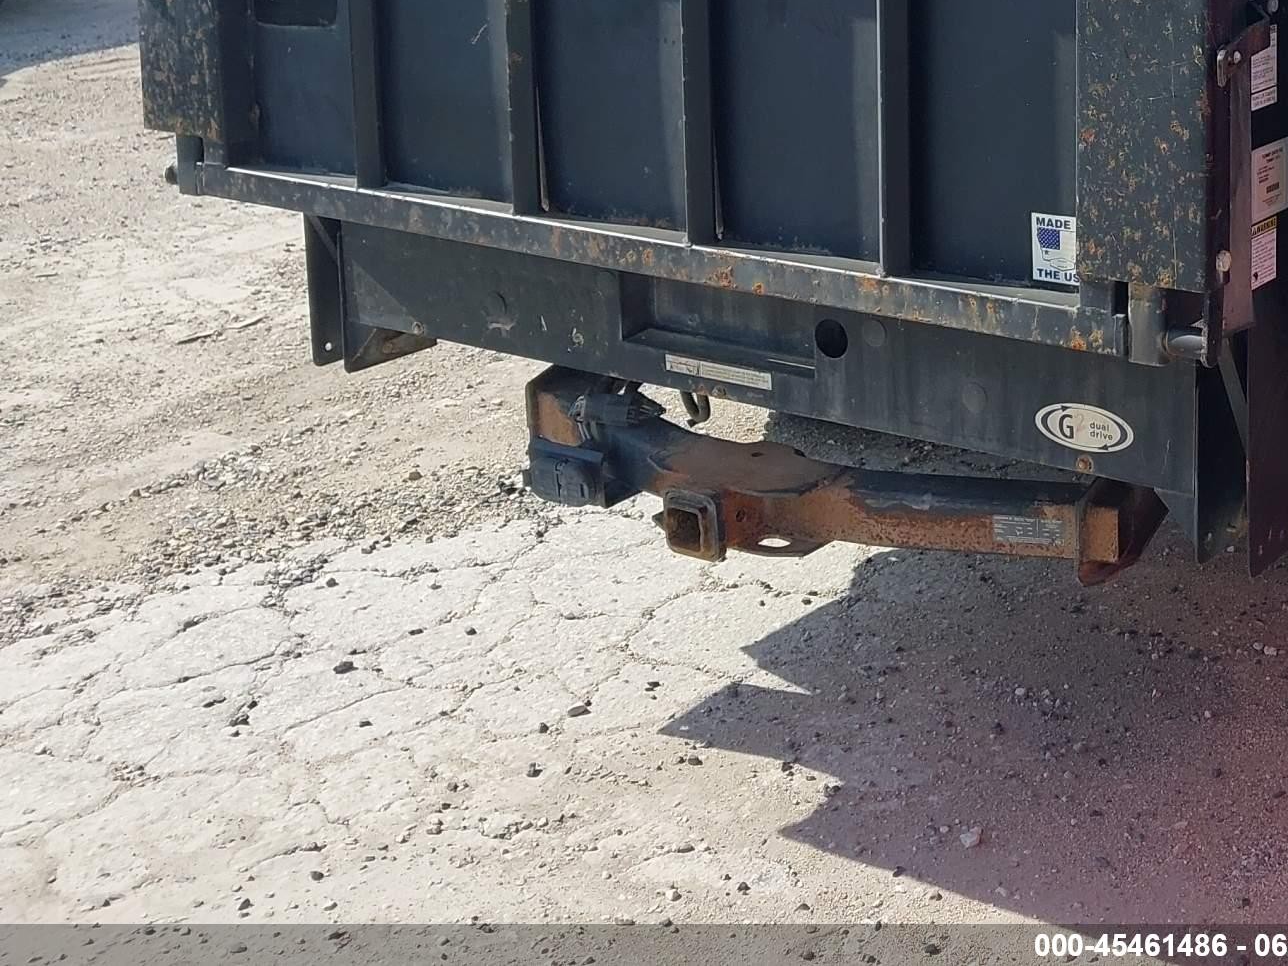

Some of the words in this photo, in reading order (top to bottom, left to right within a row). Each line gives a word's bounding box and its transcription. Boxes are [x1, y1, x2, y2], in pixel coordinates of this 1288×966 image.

[1036, 216, 1071, 229] MADE
[1036, 268, 1060, 280] THE
[1064, 272, 1080, 283] US
[1089, 421, 1110, 432] dual
[1089, 430, 1113, 441] drive
